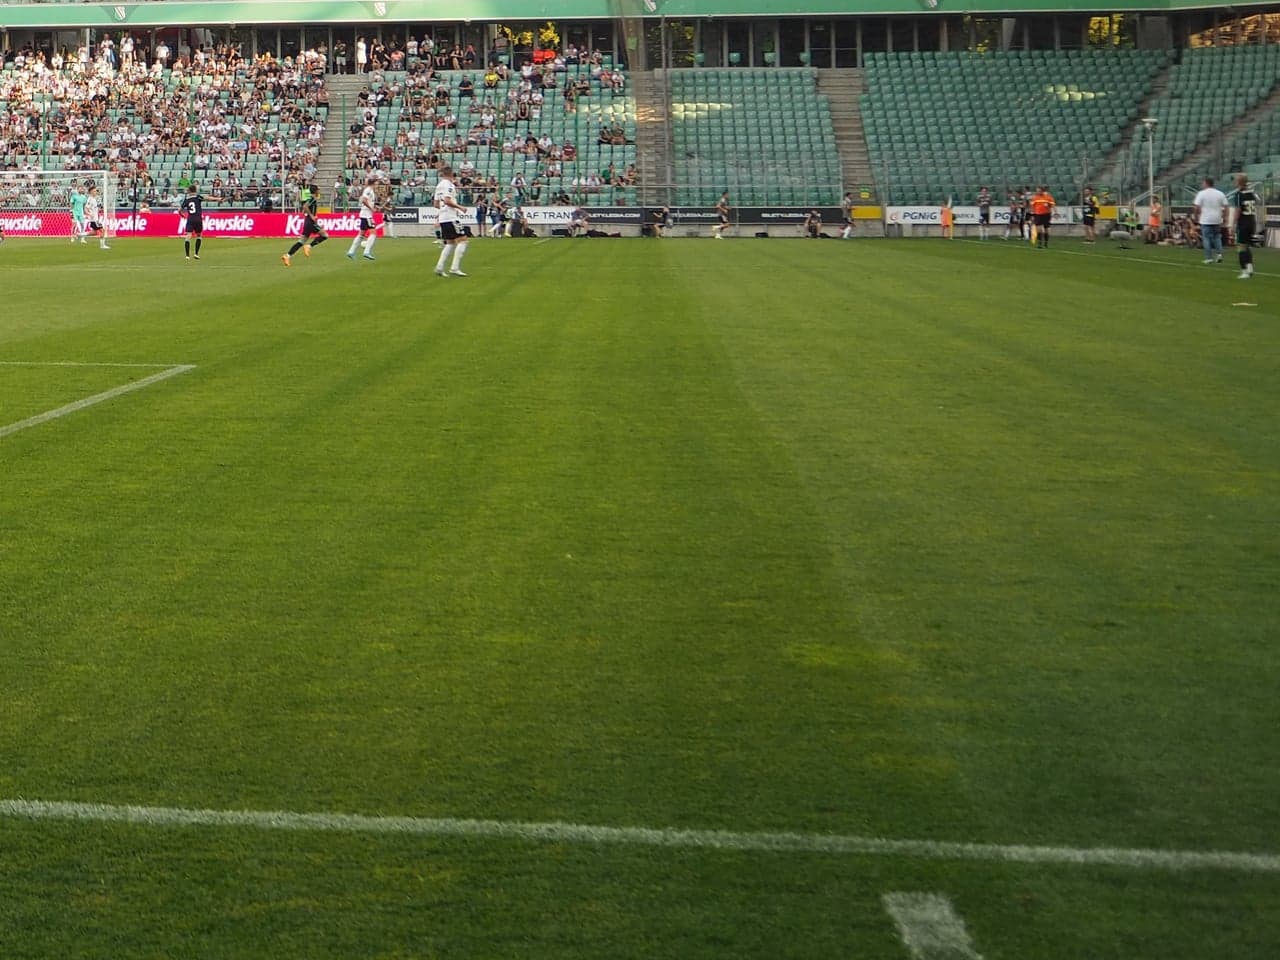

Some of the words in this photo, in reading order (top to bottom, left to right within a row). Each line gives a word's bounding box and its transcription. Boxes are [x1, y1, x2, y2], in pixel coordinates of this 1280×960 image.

[188, 202, 197, 214] 3
[526, 211, 539, 219] AF
[542, 211, 573, 219] TRAN
[903, 211, 938, 220] PGNiG
